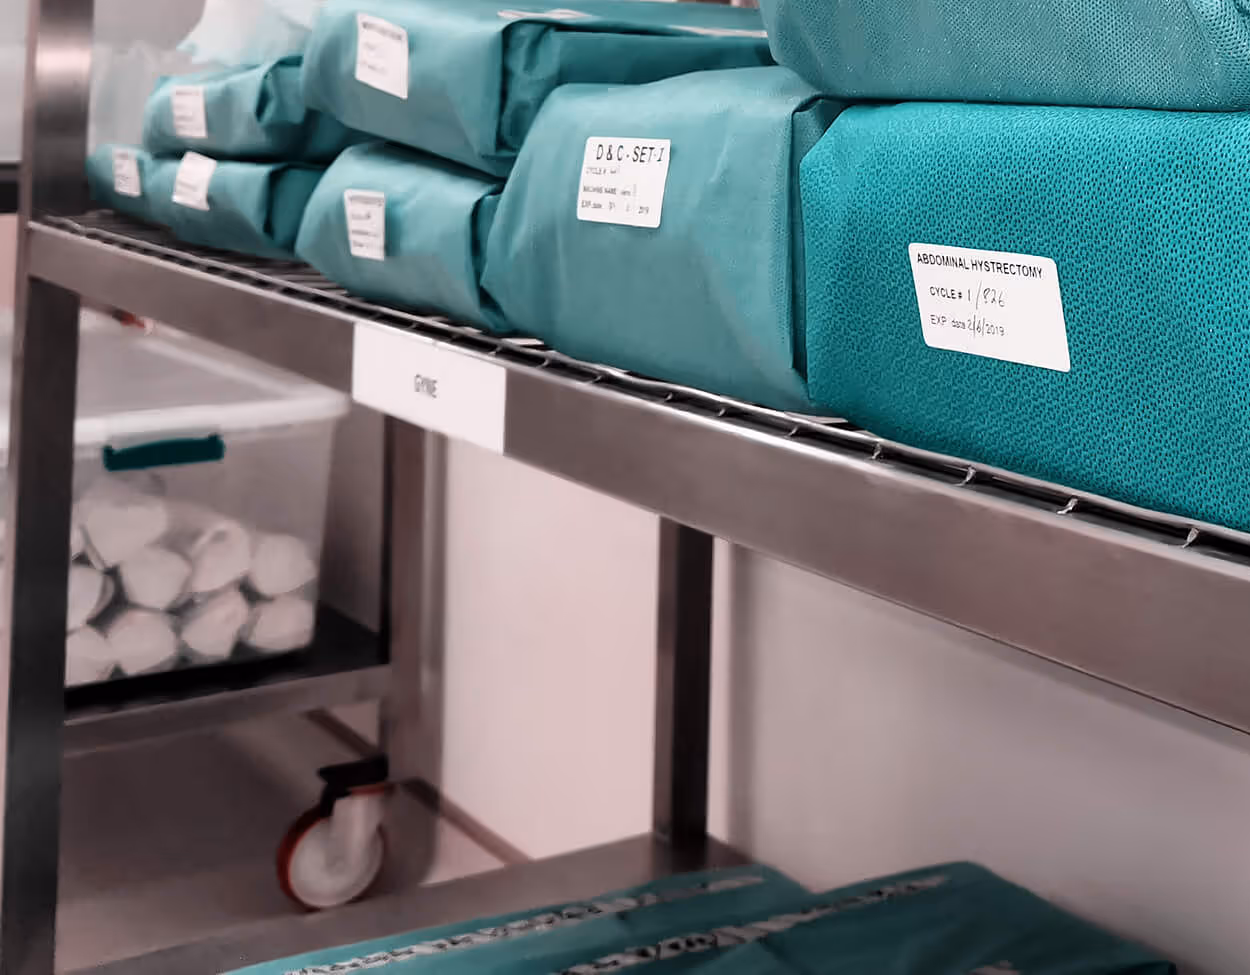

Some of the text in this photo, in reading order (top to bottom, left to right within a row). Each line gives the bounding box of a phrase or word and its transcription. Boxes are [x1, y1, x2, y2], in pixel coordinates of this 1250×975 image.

[596, 144, 603, 160] D
[606, 145, 613, 160] &
[617, 145, 623, 161] C
[917, 253, 1043, 279] ABDOMINAL HYSTRECTOMY
[930, 286, 957, 299] CYCLE
